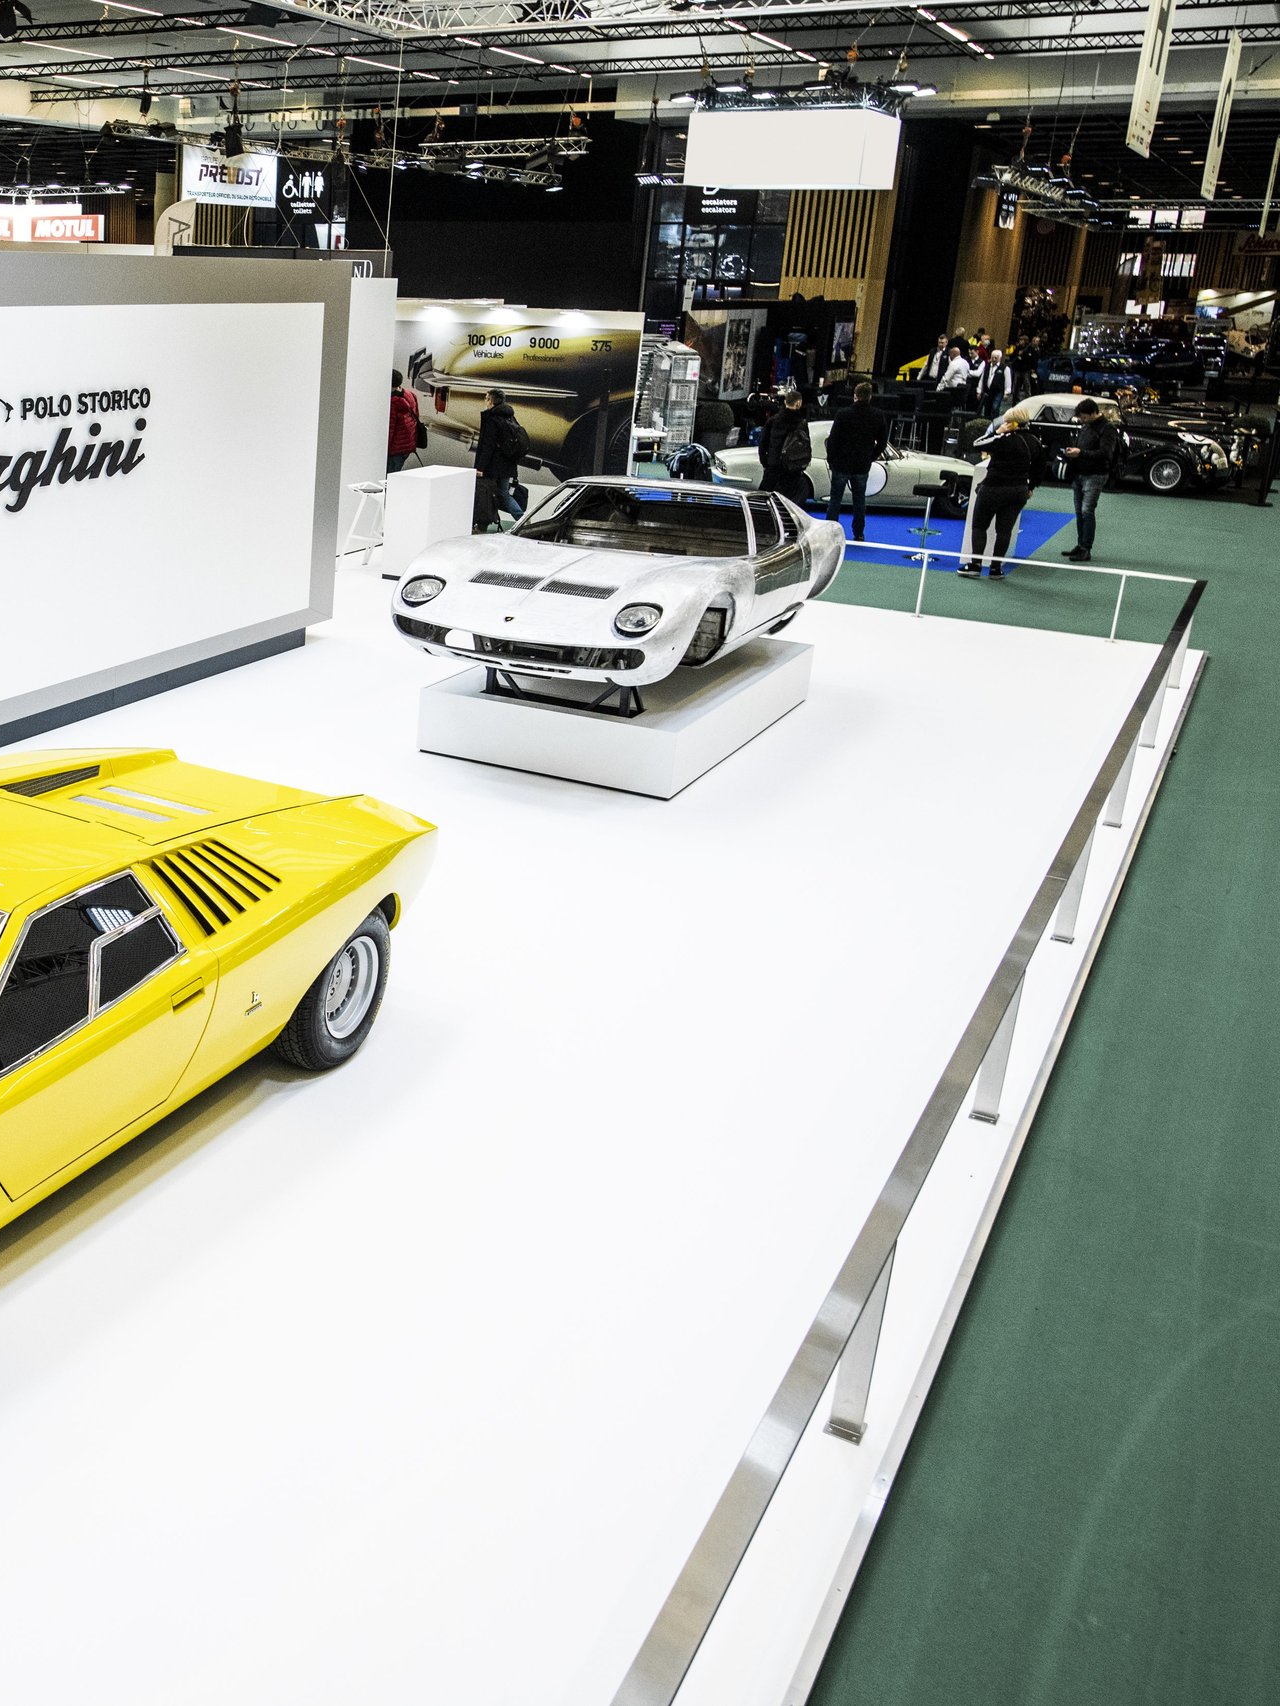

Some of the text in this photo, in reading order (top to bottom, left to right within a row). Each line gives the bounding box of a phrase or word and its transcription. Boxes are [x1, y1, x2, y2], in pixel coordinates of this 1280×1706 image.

[701, 206, 736, 214] escalators
[34, 219, 95, 238] MOTUL
[467, 334, 512, 348] 100 000
[591, 340, 612, 352] 375
[473, 350, 504, 359] Véhicules
[21, 387, 151, 420] POLO STORICO
